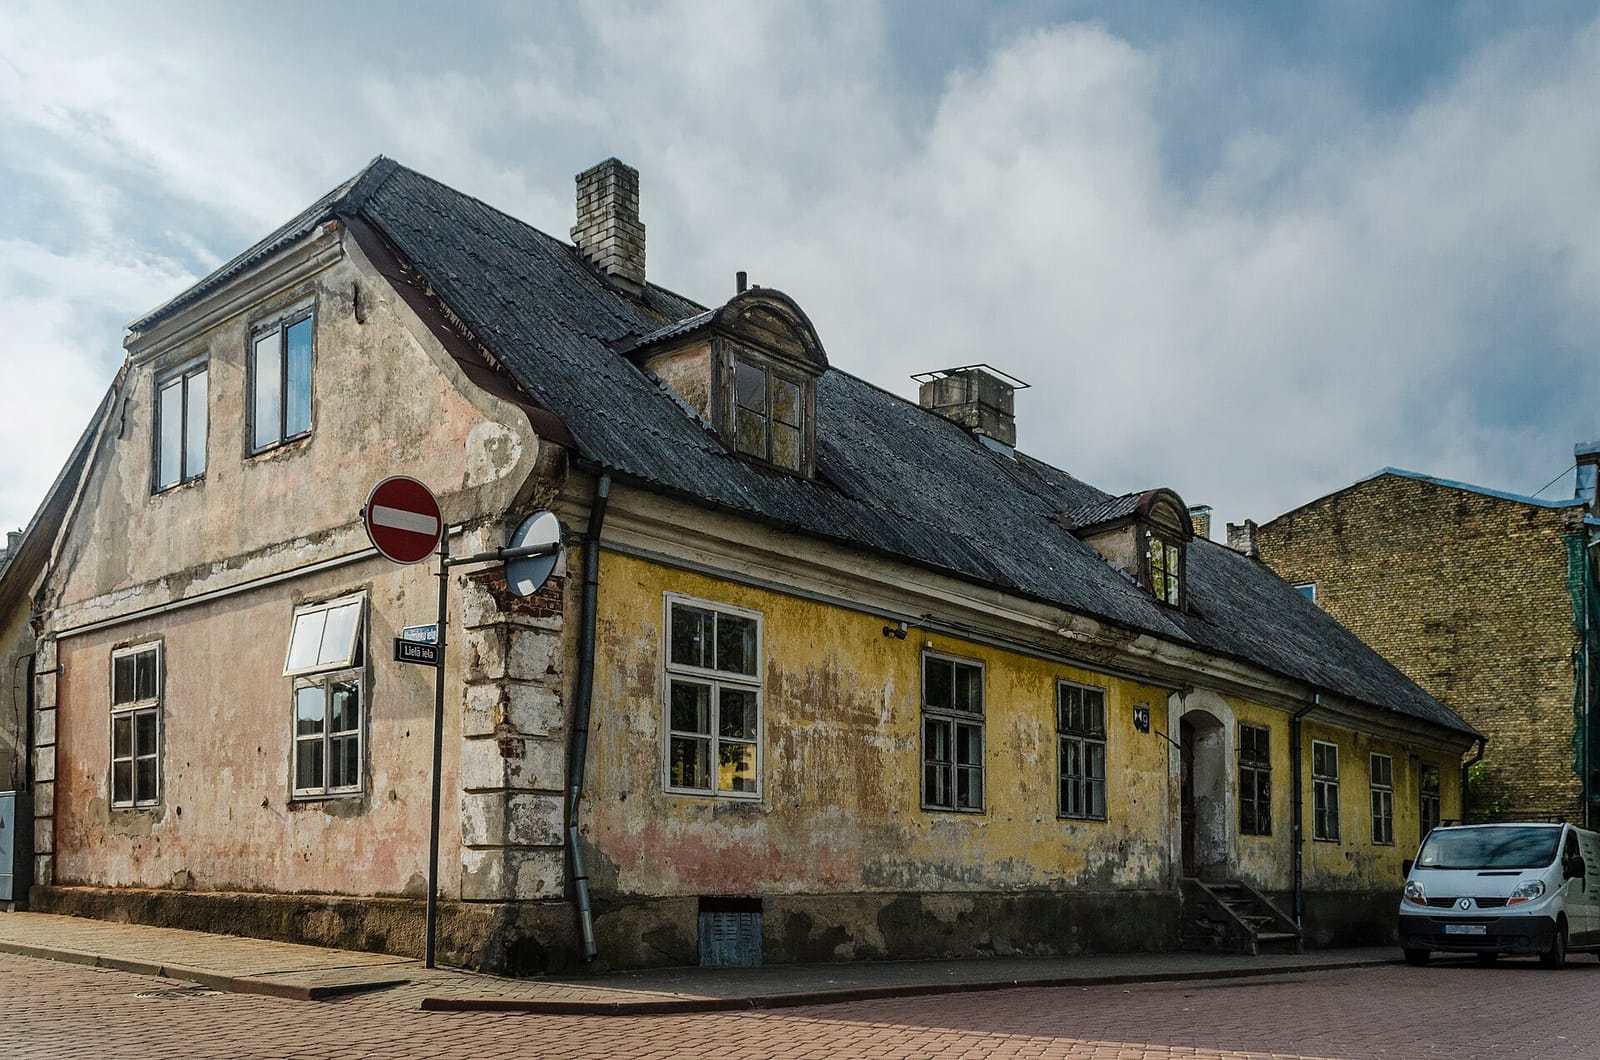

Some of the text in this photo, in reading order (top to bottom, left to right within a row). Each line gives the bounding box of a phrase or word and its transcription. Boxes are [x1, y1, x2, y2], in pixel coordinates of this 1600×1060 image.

[404, 645, 433, 659] Lielā iela
[1142, 714, 1148, 728] 9
